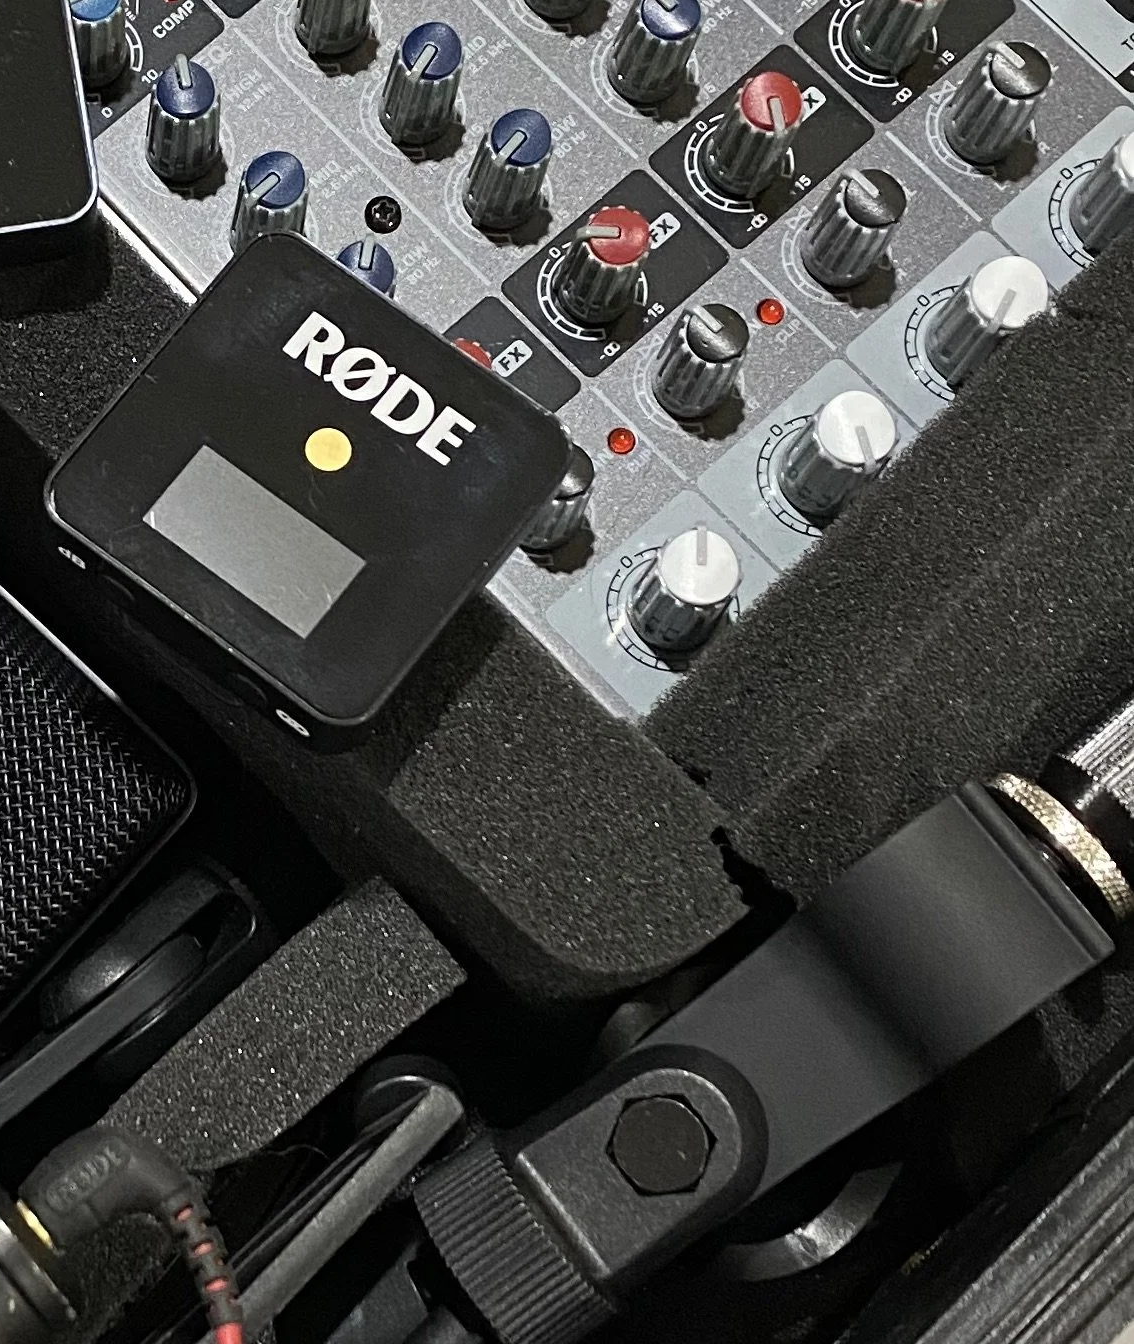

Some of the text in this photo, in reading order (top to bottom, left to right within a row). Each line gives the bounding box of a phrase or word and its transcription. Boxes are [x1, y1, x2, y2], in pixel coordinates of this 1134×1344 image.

[141, 68, 160, 84] 10
[101, 106, 113, 119] 0
[1059, 167, 1074, 181] 0
[549, 246, 561, 259] 0
[917, 294, 931, 308] 0
[497, 346, 527, 372] FX
[281, 310, 477, 467] RØDE
[769, 424, 783, 437] 0
[620, 555, 634, 569] 0
